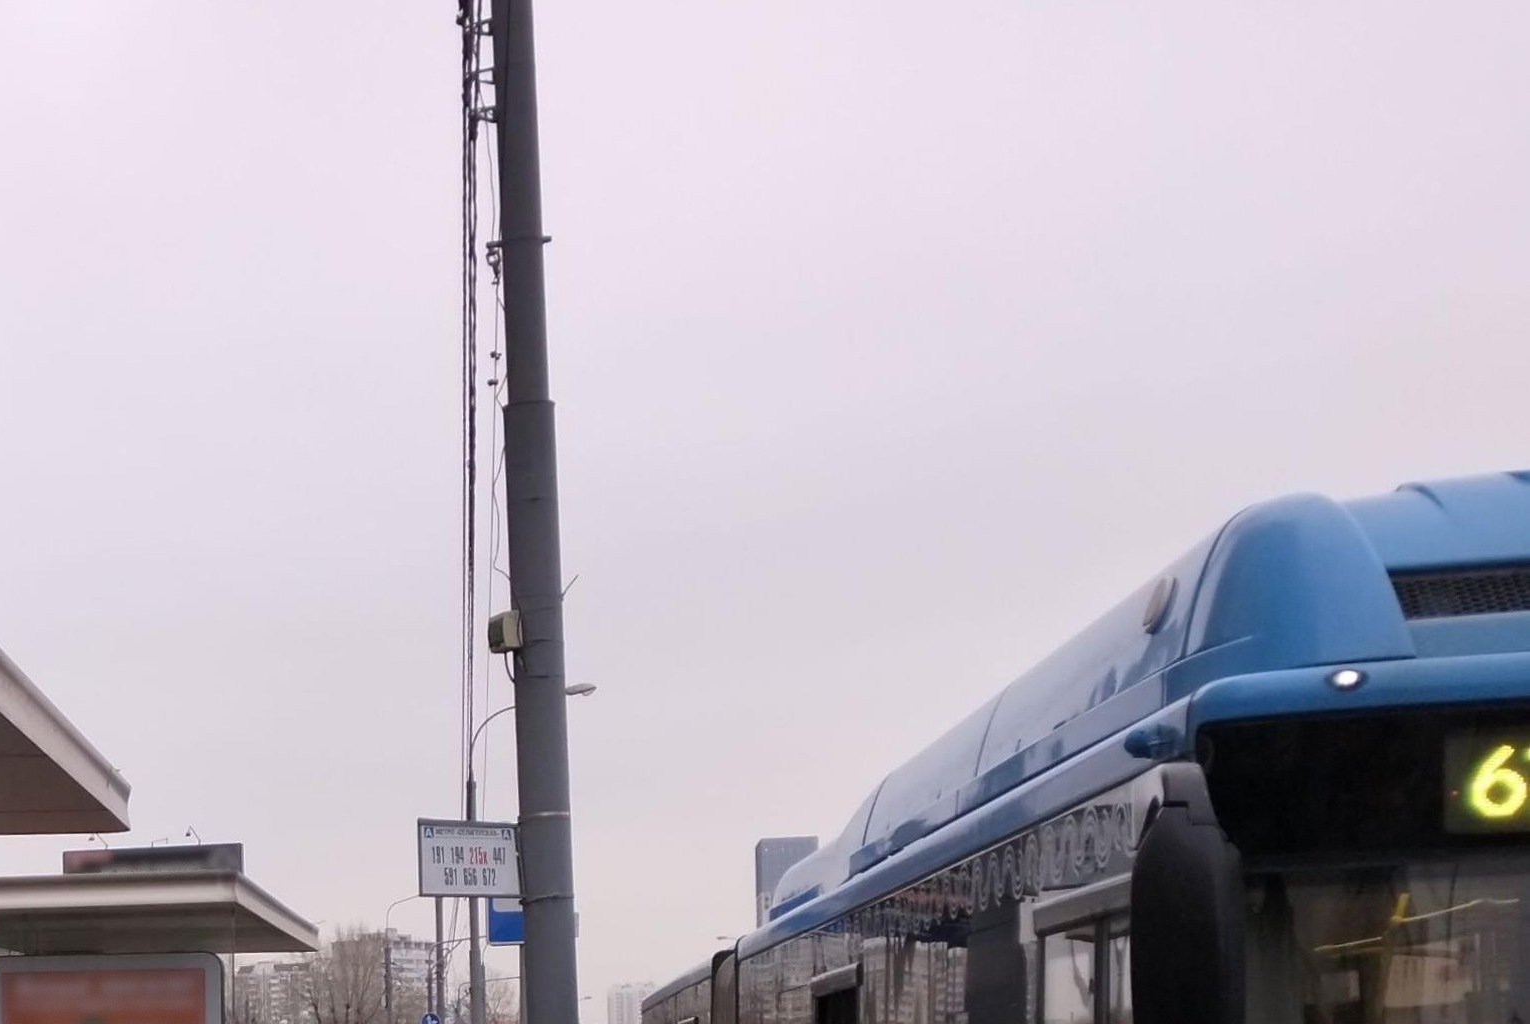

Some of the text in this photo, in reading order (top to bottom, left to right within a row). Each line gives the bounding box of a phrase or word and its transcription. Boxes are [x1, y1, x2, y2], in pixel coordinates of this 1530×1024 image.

[1471, 744, 1530, 817] 6
[492, 847, 506, 865] 447
[482, 867, 496, 886] 672
